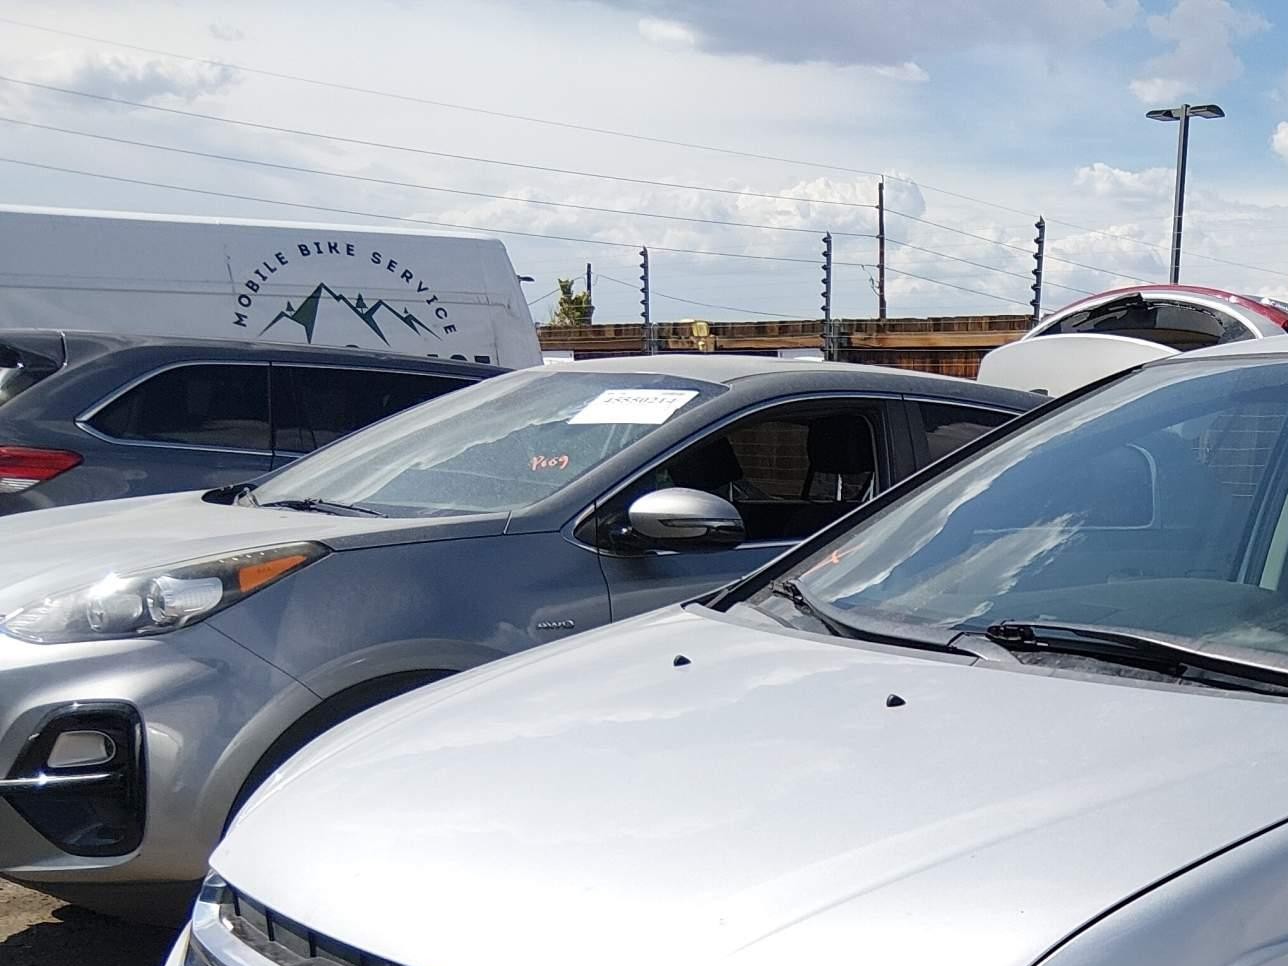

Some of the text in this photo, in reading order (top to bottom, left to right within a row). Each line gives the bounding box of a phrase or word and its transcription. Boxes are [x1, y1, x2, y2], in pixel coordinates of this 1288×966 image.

[232, 241, 457, 335] MOBILE BIKE SERVICE
